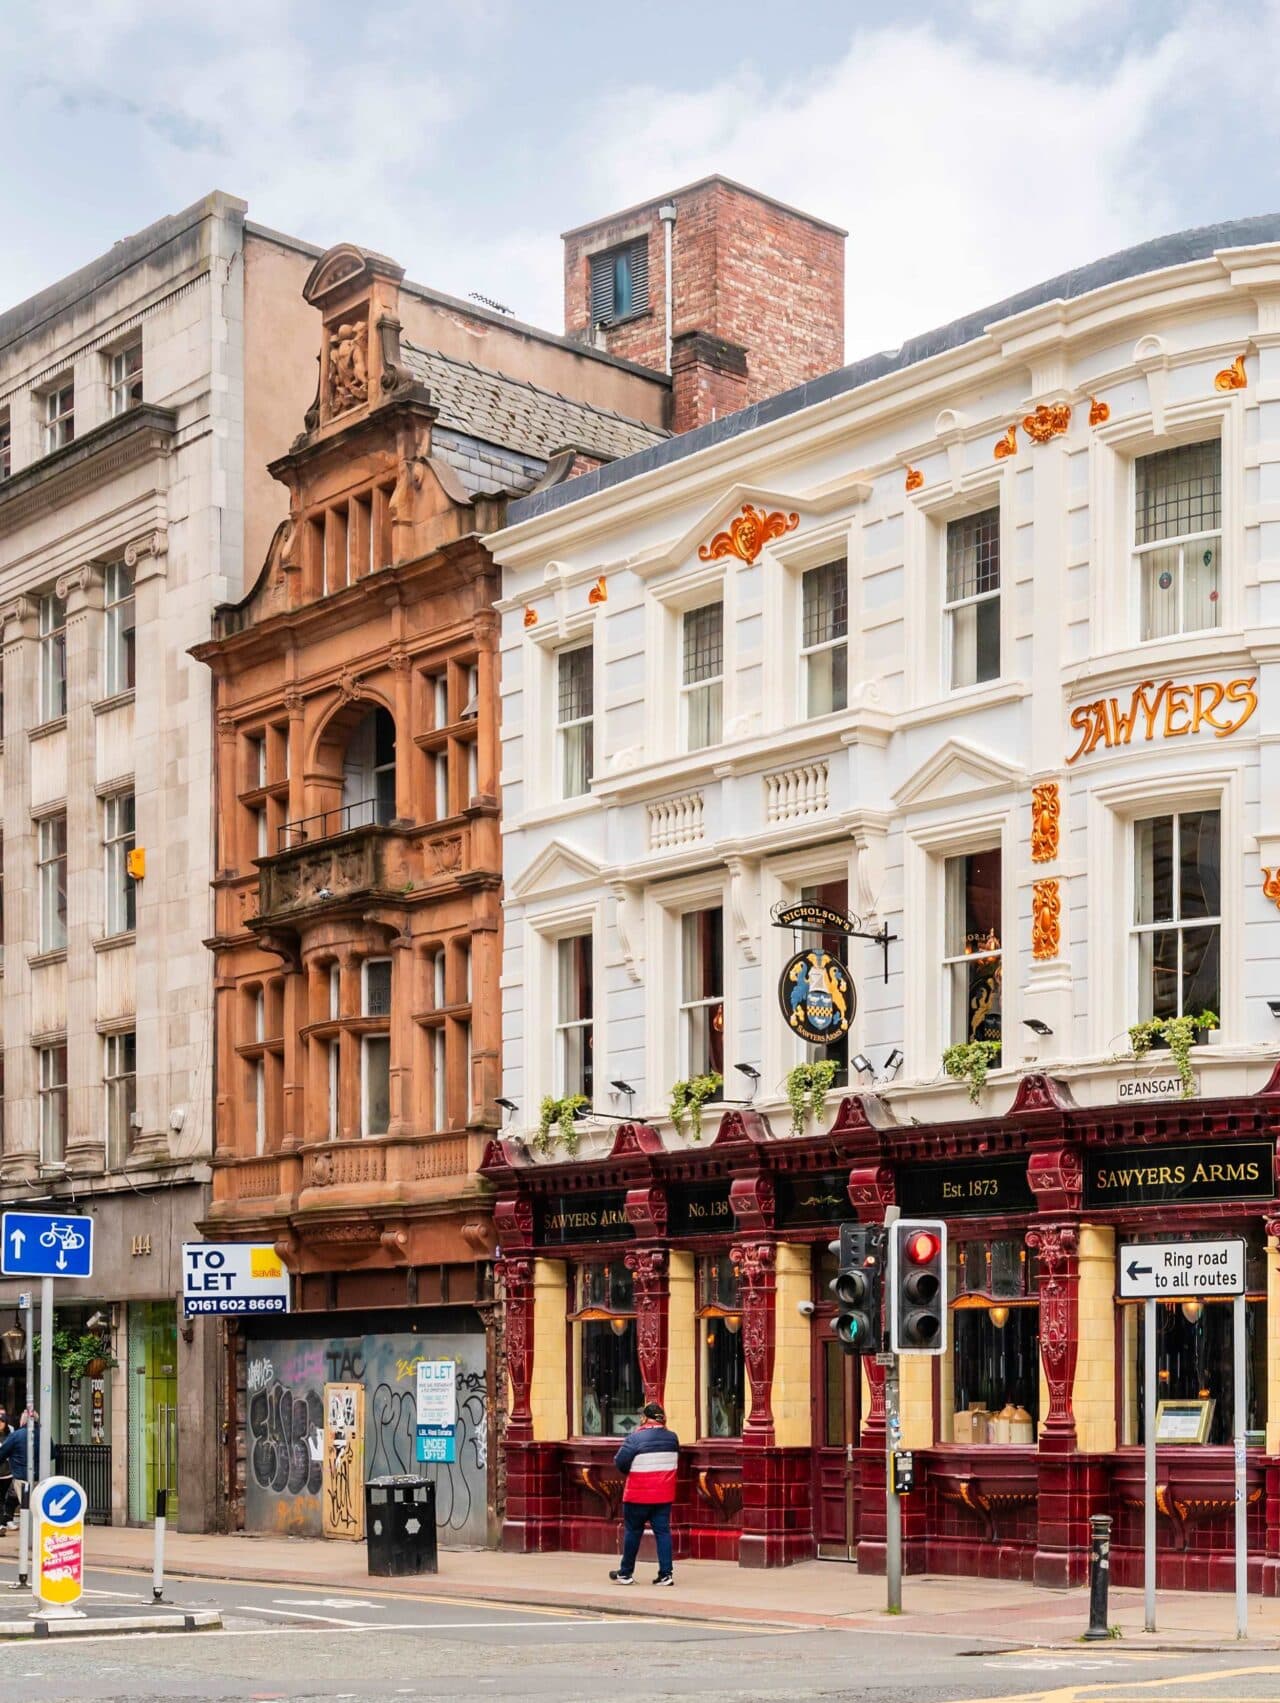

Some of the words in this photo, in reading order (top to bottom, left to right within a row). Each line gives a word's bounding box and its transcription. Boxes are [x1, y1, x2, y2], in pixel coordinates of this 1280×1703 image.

[1066, 676, 1258, 765] SAWYERS
[783, 908, 850, 931] NICHOLSON'S
[797, 1025, 825, 1042] SAWYERS
[1119, 1079, 1187, 1097] DEANSGAT
[1096, 1165, 1185, 1190] SAWYERS
[1193, 1162, 1260, 1183] ARMS
[943, 1182, 966, 1199] Est.
[968, 1179, 999, 1196] 1873
[688, 1202, 708, 1218] No.
[710, 1201, 729, 1217] 138
[544, 1210, 597, 1230] SAWYERS
[600, 1208, 628, 1228] ARM
[132, 1233, 151, 1256] 144
[187, 1250, 225, 1269] TO
[1164, 1251, 1193, 1269] Ring
[1198, 1249, 1228, 1266] road
[187, 1273, 237, 1291] LET
[252, 1268, 281, 1278] savills
[1155, 1273, 1168, 1288] to
[1173, 1271, 1189, 1287] all
[1194, 1271, 1237, 1286] routes
[188, 1300, 217, 1311] 0161
[220, 1300, 246, 1310] 602
[249, 1299, 283, 1310] 8669
[420, 1365, 432, 1379] TO
[434, 1365, 452, 1379] LET
[422, 1438, 447, 1449] UNDER
[423, 1449, 446, 1460] OFFER
